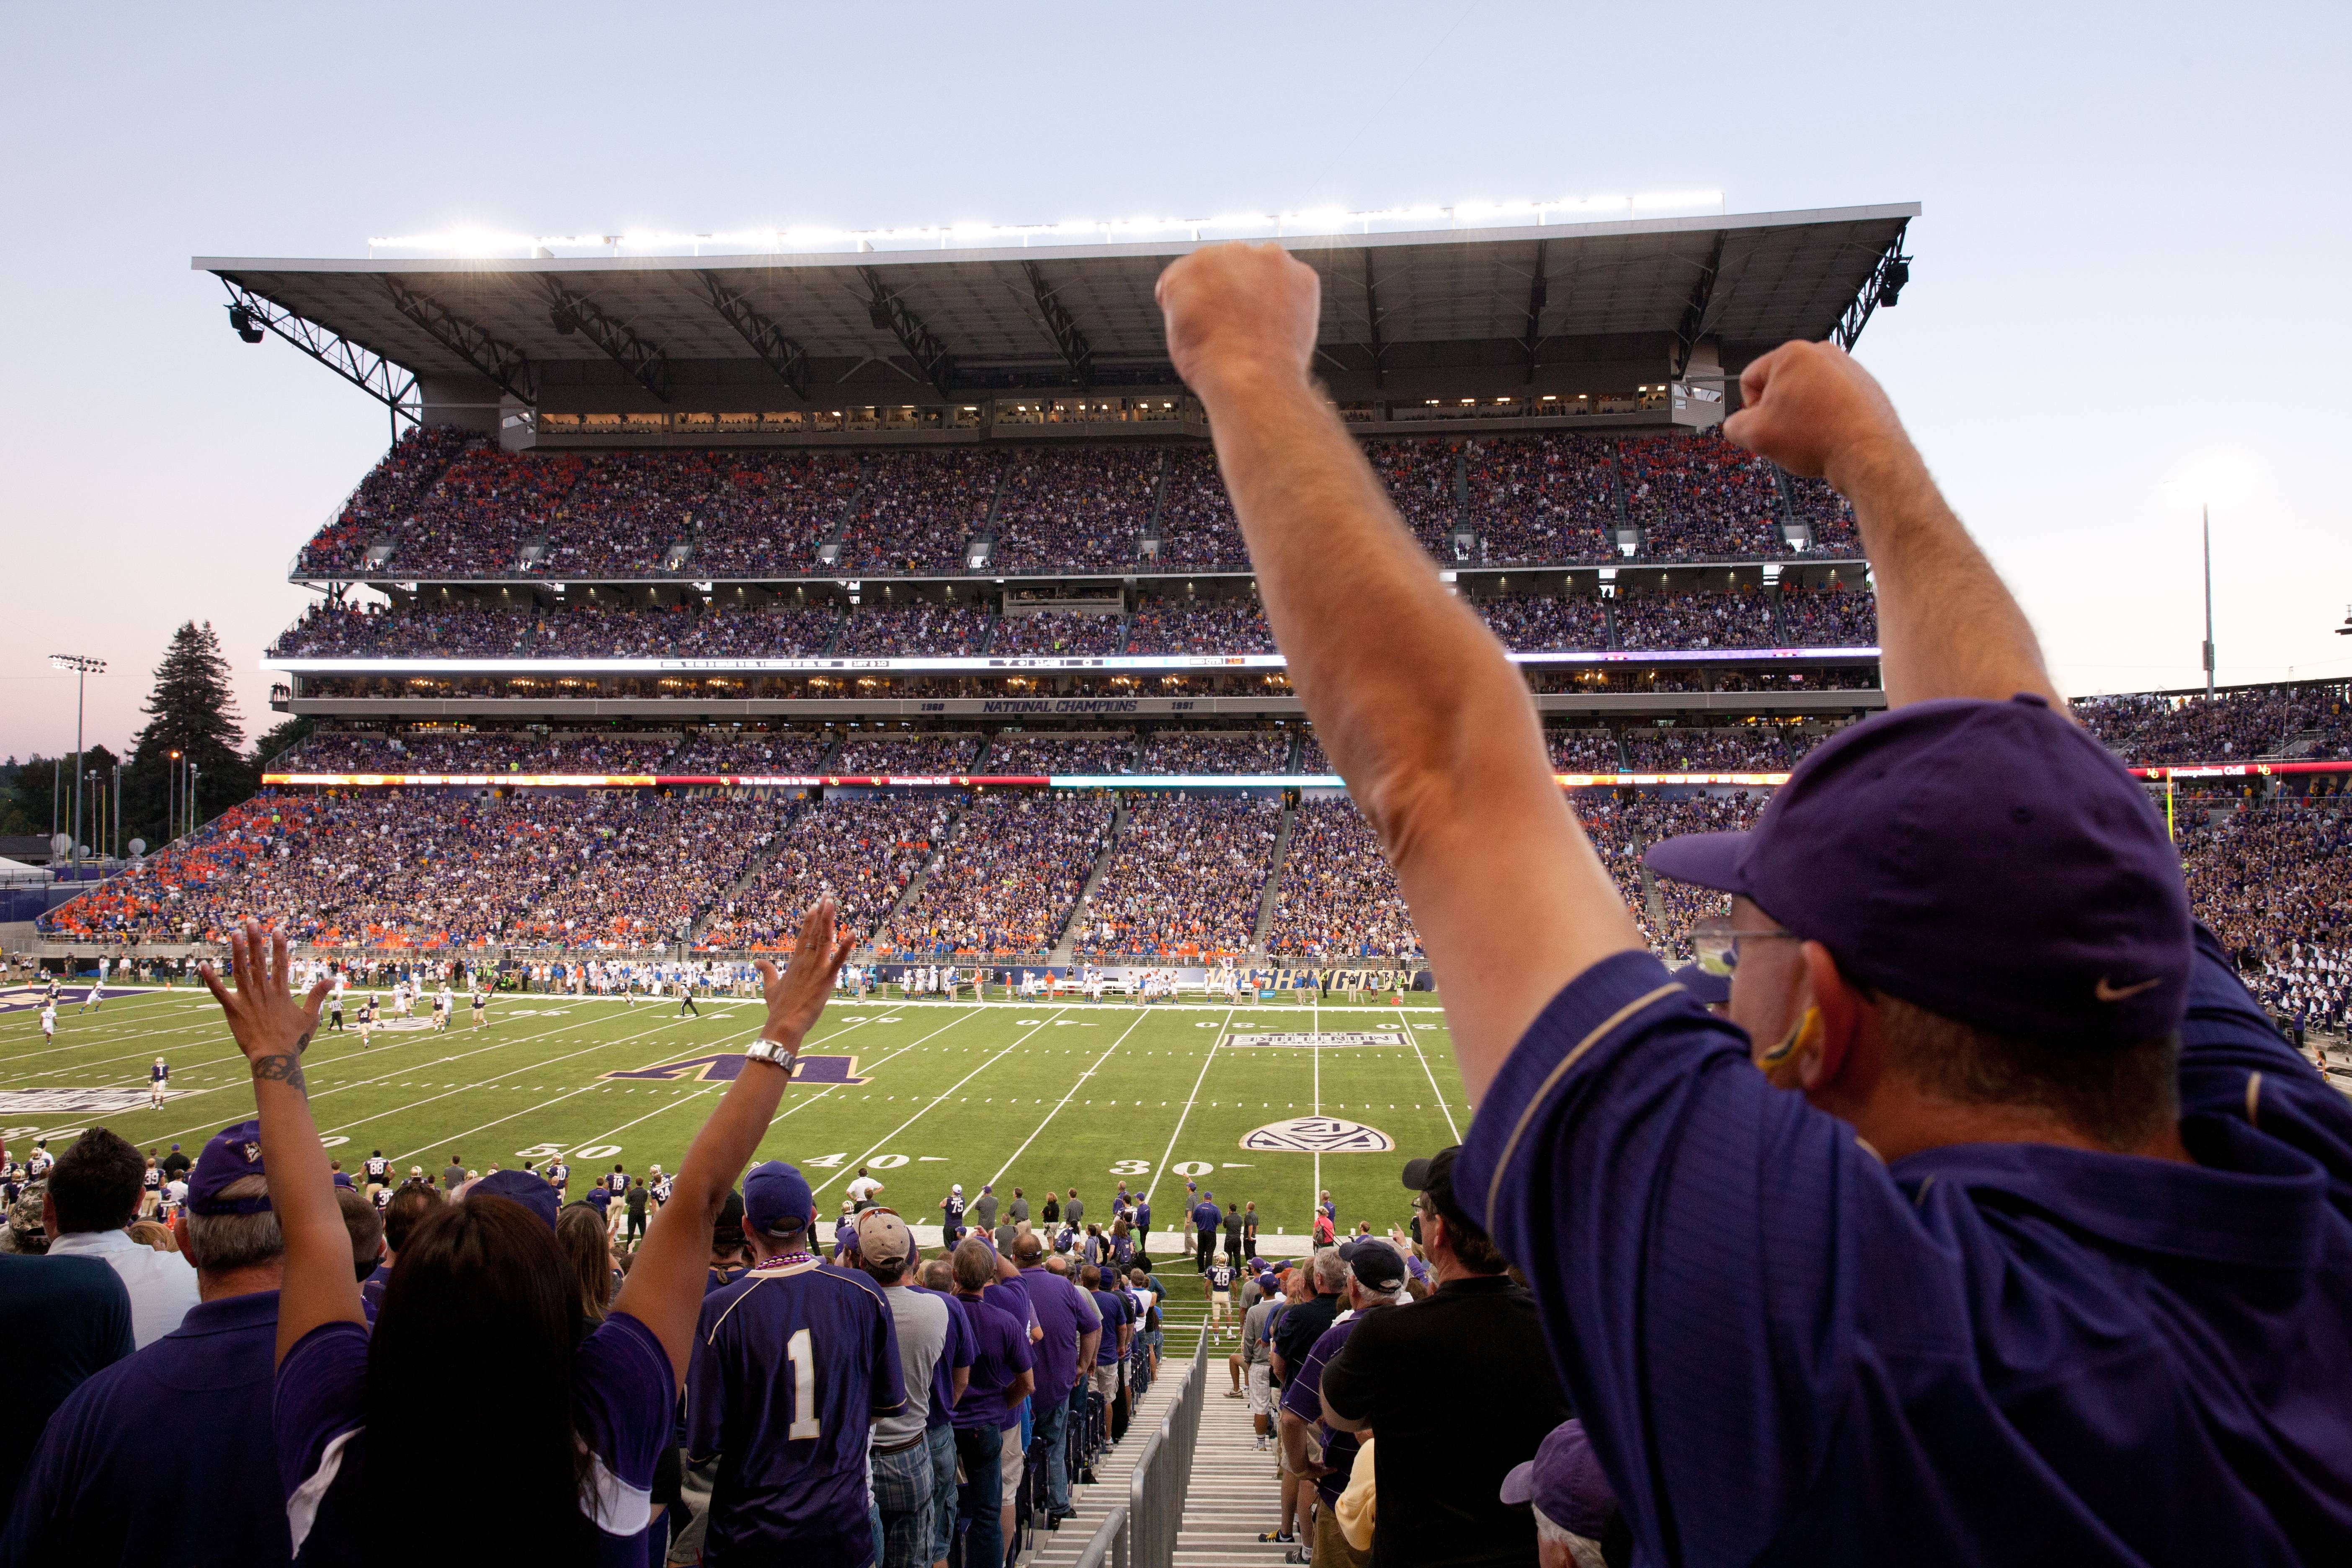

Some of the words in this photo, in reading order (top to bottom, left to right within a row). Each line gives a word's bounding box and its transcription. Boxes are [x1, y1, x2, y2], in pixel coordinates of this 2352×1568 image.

[983, 701, 1051, 712] NATIONAL
[1055, 701, 1137, 712] CHAMPIONS
[2169, 767, 2223, 778] Metropolitan
[2224, 766, 2245, 775] Grill
[890, 777, 933, 786] Metropolitan
[159, 1067, 163, 1076] 1
[516, 1143, 622, 1159] 50
[802, 1153, 909, 1169] 40
[370, 1163, 384, 1175] 88
[557, 1168, 566, 1181] 10
[1109, 1160, 1214, 1176] 30
[144, 1173, 159, 1185] 39
[613, 1178, 624, 1190] 18
[657, 1186, 671, 1201] 34
[951, 1200, 963, 1213] 75
[1214, 1272, 1230, 1286] 48
[788, 1328, 820, 1441] 1
